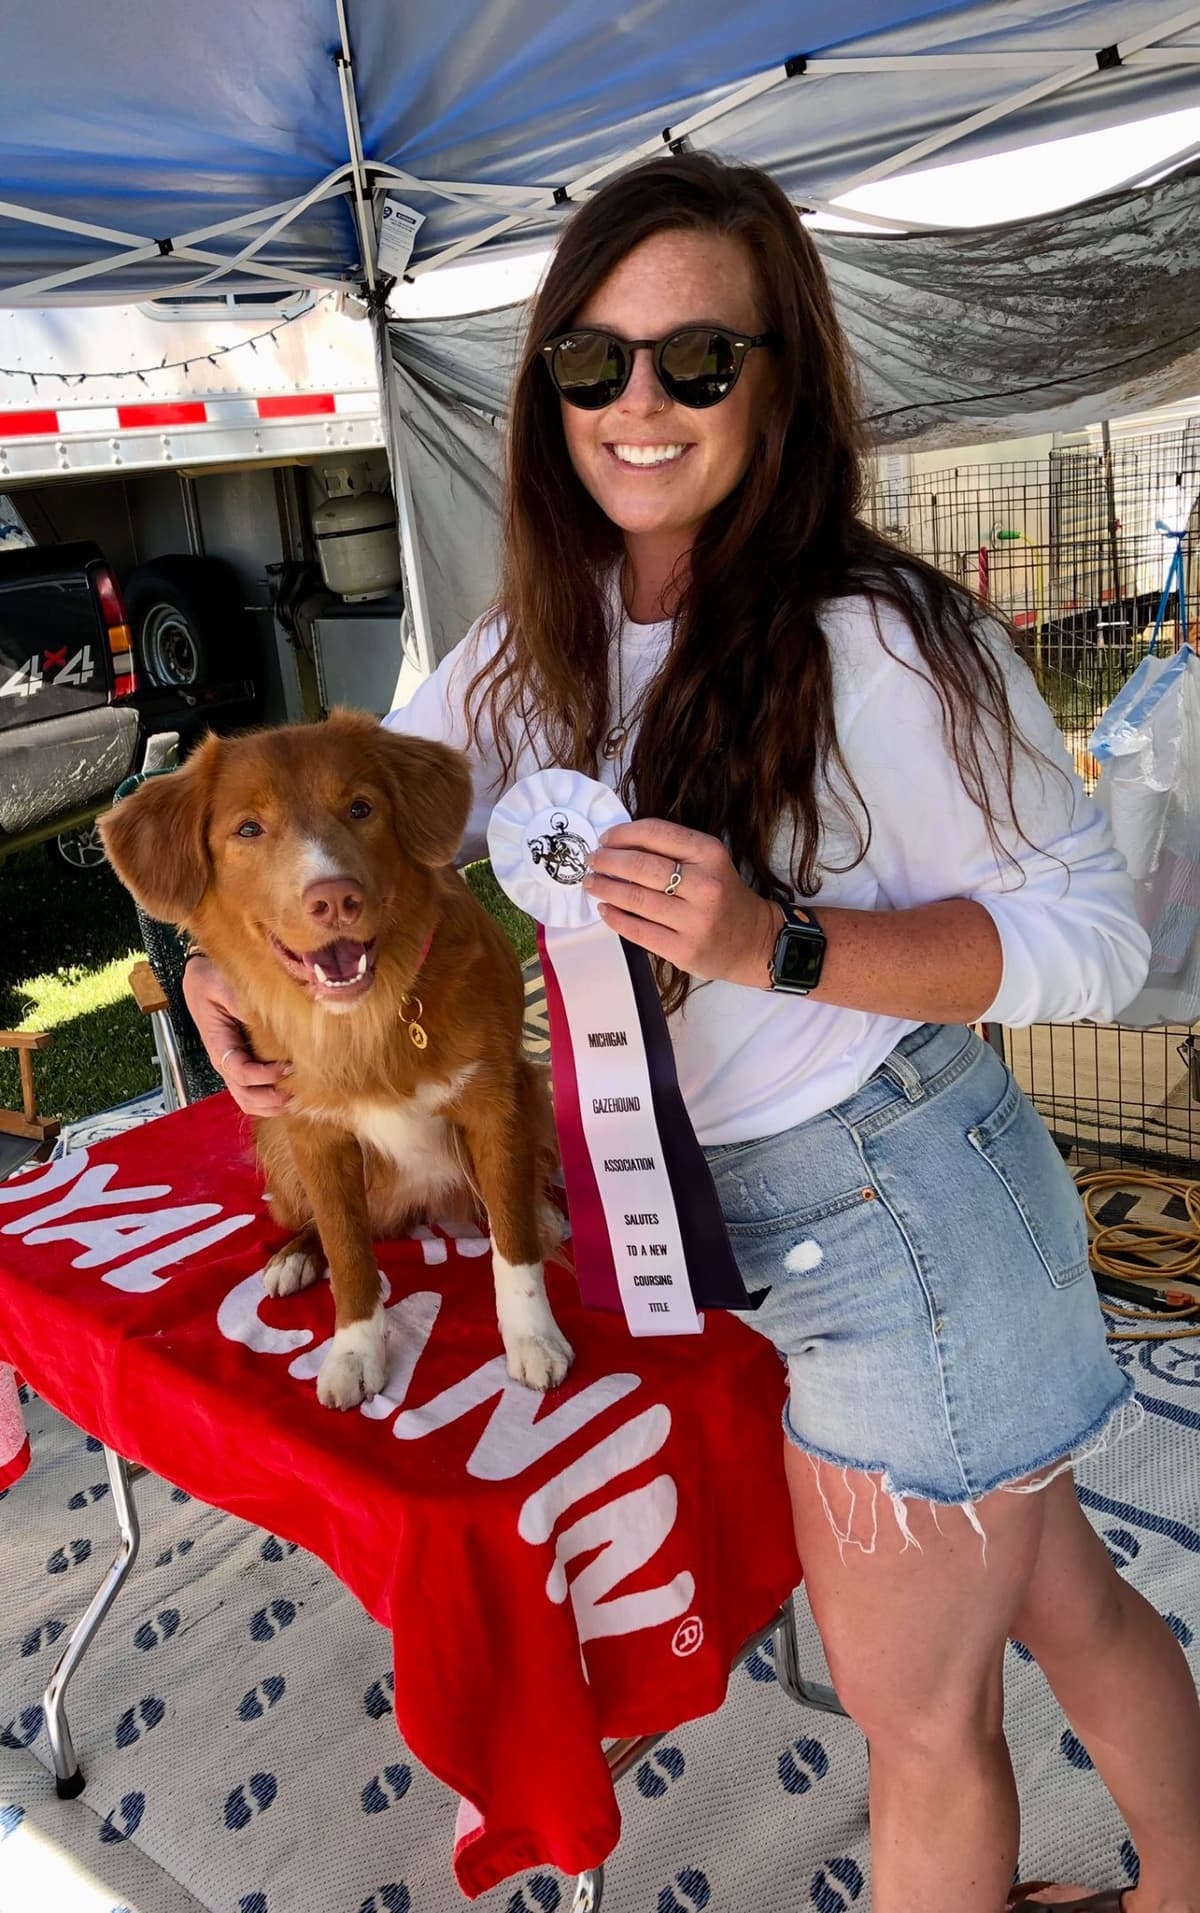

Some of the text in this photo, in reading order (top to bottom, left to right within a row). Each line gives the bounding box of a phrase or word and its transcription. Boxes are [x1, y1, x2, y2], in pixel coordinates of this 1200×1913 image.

[587, 1031, 628, 1048] MICHIGAN
[592, 1096, 641, 1114] GAZEHOUND
[603, 1157, 656, 1173] ASSOCIATION
[623, 1213, 660, 1226] SALUTES
[626, 1244, 668, 1257] TO A NEW
[633, 1274, 673, 1287] COURSING
[647, 1302, 670, 1313] TITLE
